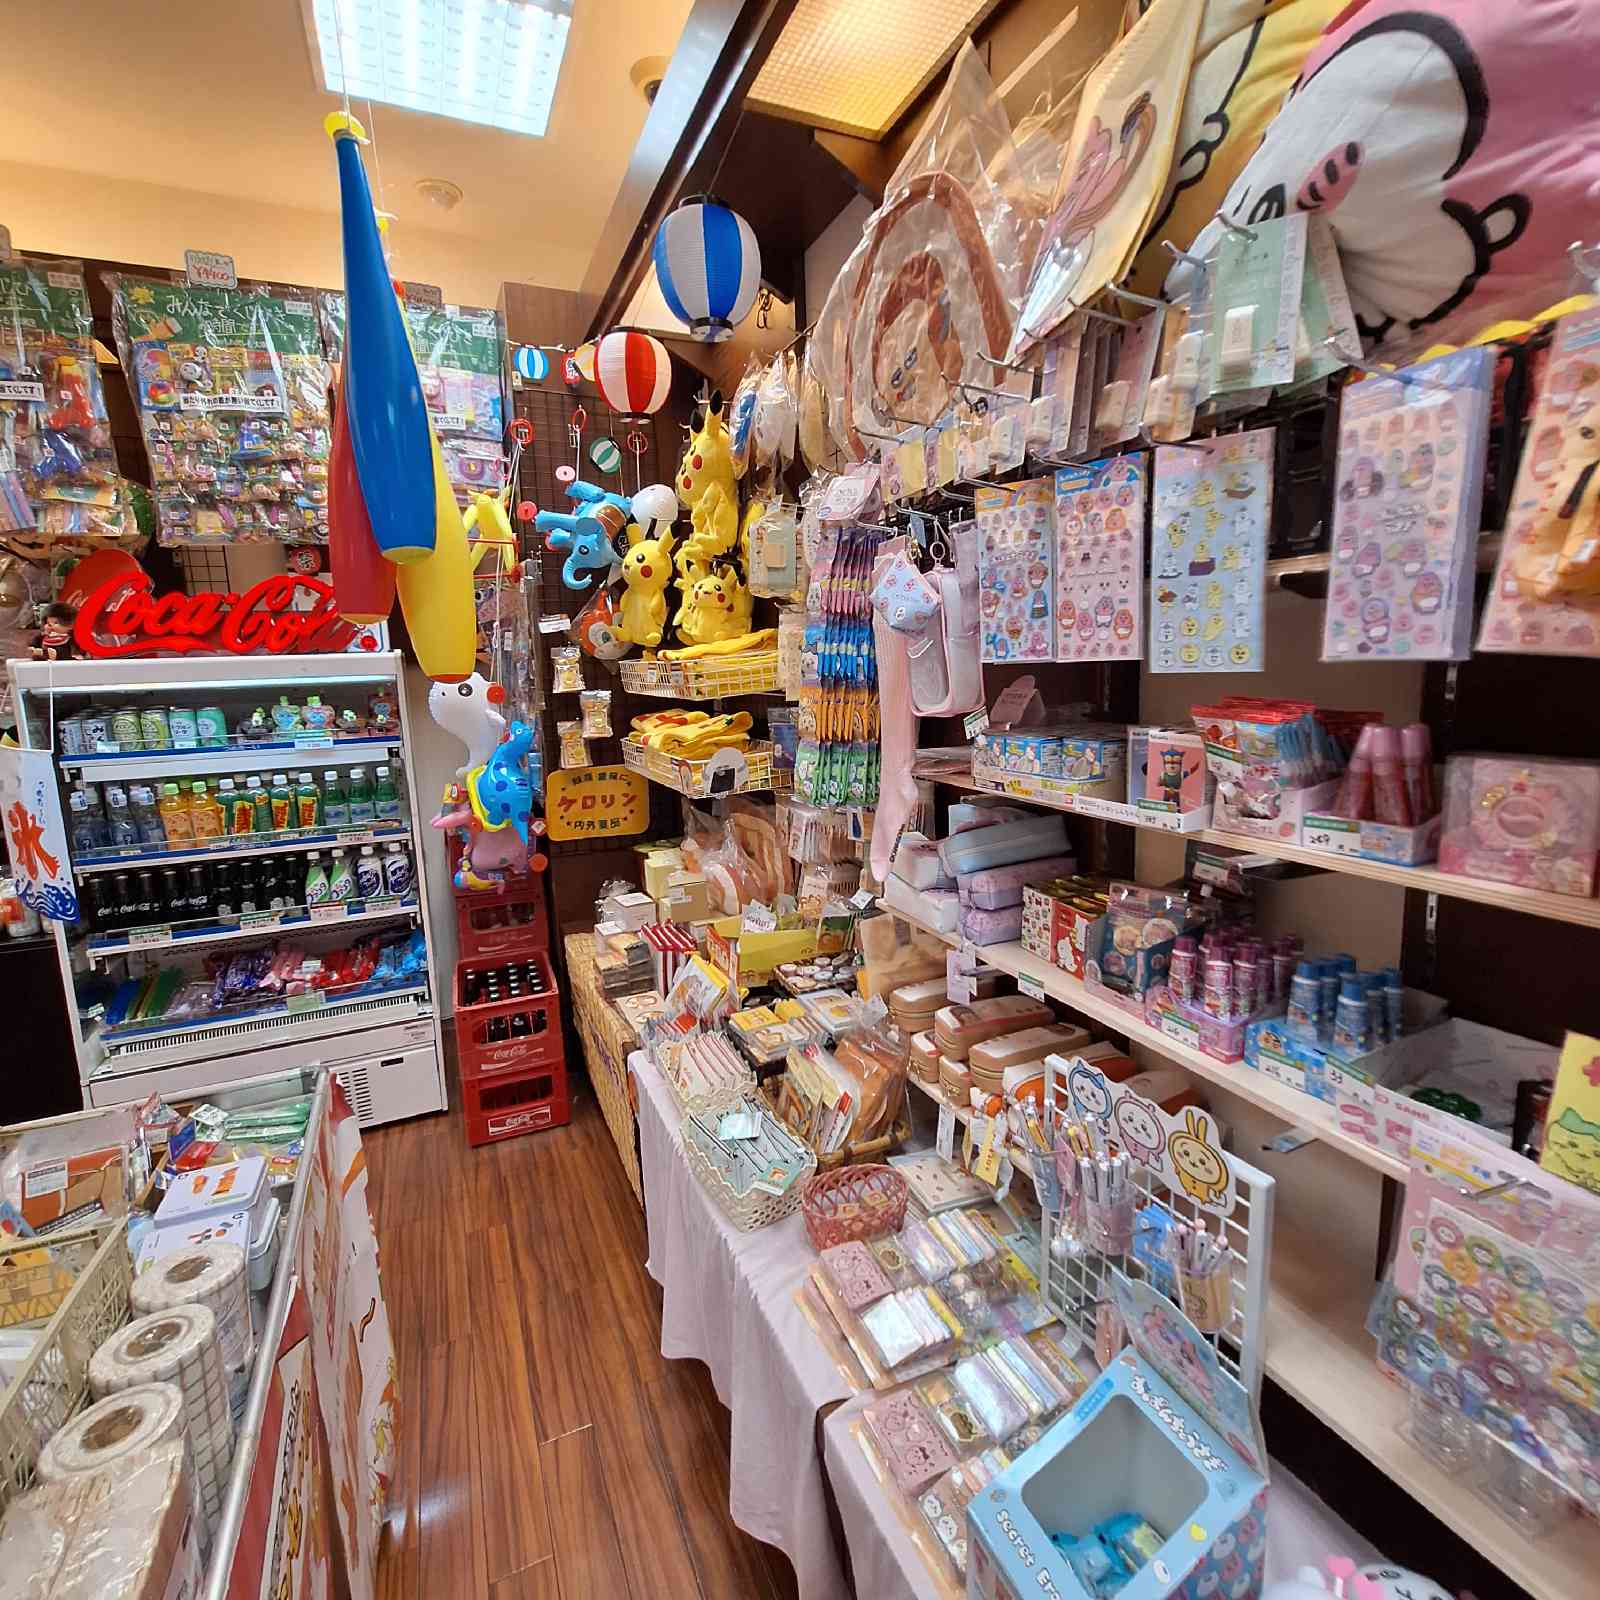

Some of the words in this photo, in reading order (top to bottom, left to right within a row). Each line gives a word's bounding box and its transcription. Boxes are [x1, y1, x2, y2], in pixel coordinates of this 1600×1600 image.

[557, 792, 640, 813] ケロリン
[8, 800, 60, 881] 氷
[995, 1510, 1036, 1568] Secret
